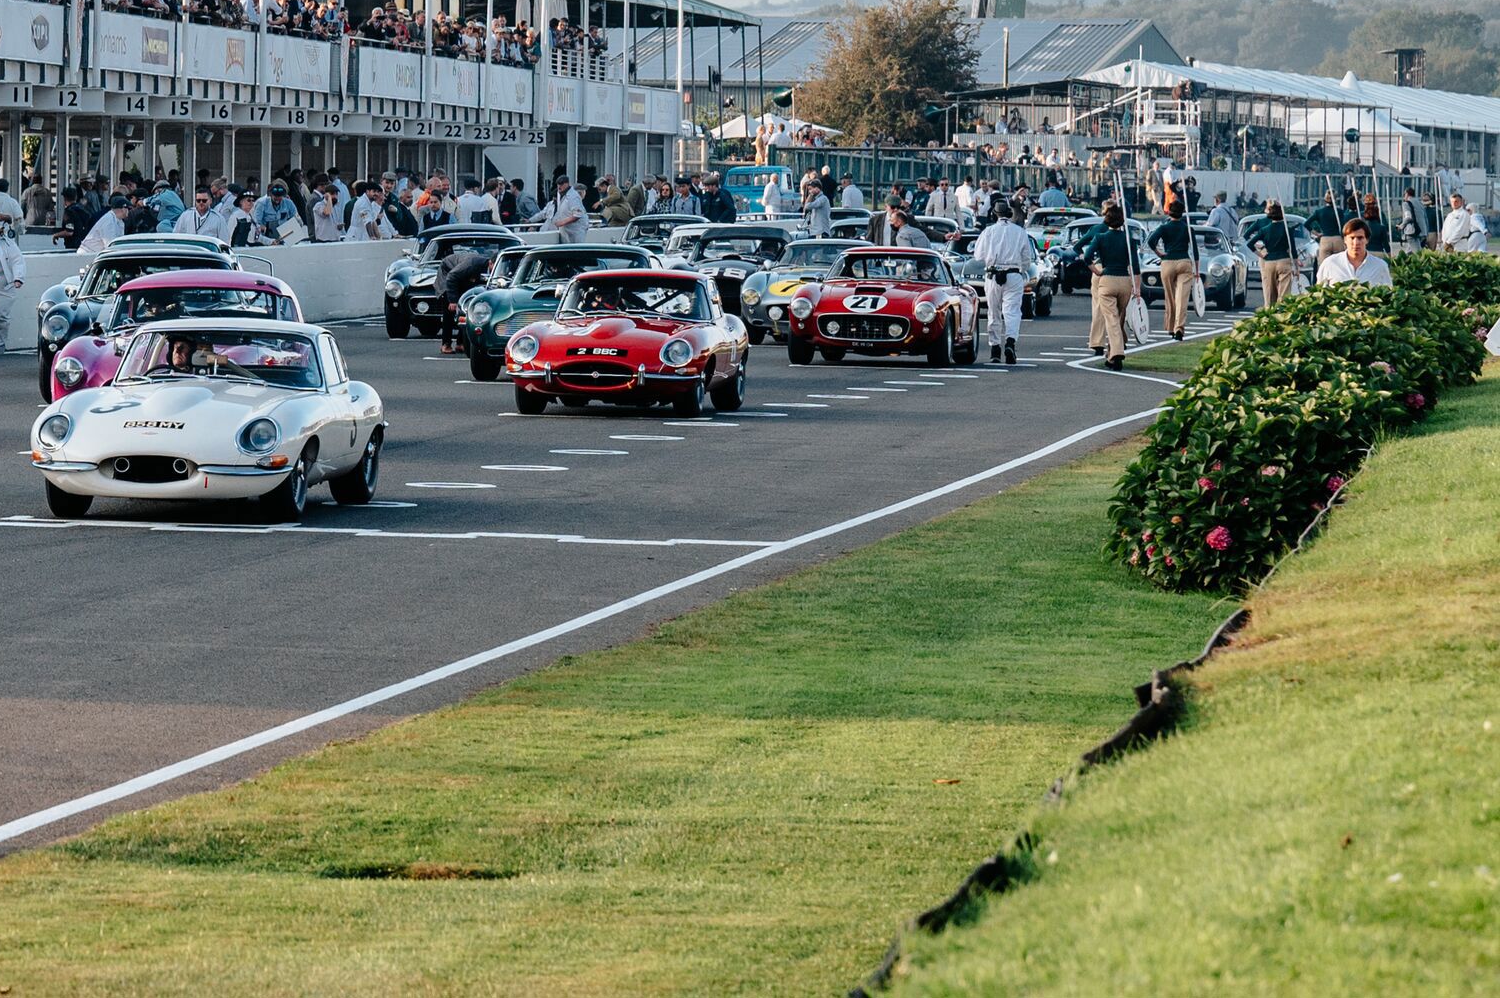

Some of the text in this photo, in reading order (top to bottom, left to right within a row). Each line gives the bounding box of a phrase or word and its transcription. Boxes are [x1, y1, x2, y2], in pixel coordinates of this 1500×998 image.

[13, 86, 29, 103] 11
[58, 90, 78, 107] 12
[126, 96, 145, 112] 14
[171, 100, 189, 116] 15
[211, 104, 229, 119] 16
[250, 106, 268, 121] 17
[288, 110, 305, 125] 18
[323, 113, 340, 128] 19
[382, 118, 402, 133] 20
[416, 122, 432, 136] 21
[444, 124, 462, 138] 22
[473, 127, 491, 140] 23
[499, 129, 517, 142] 24
[527, 131, 545, 144] 25
[850, 296, 881, 310] 21
[577, 347, 587, 355] 2
[89, 401, 142, 414] 3
